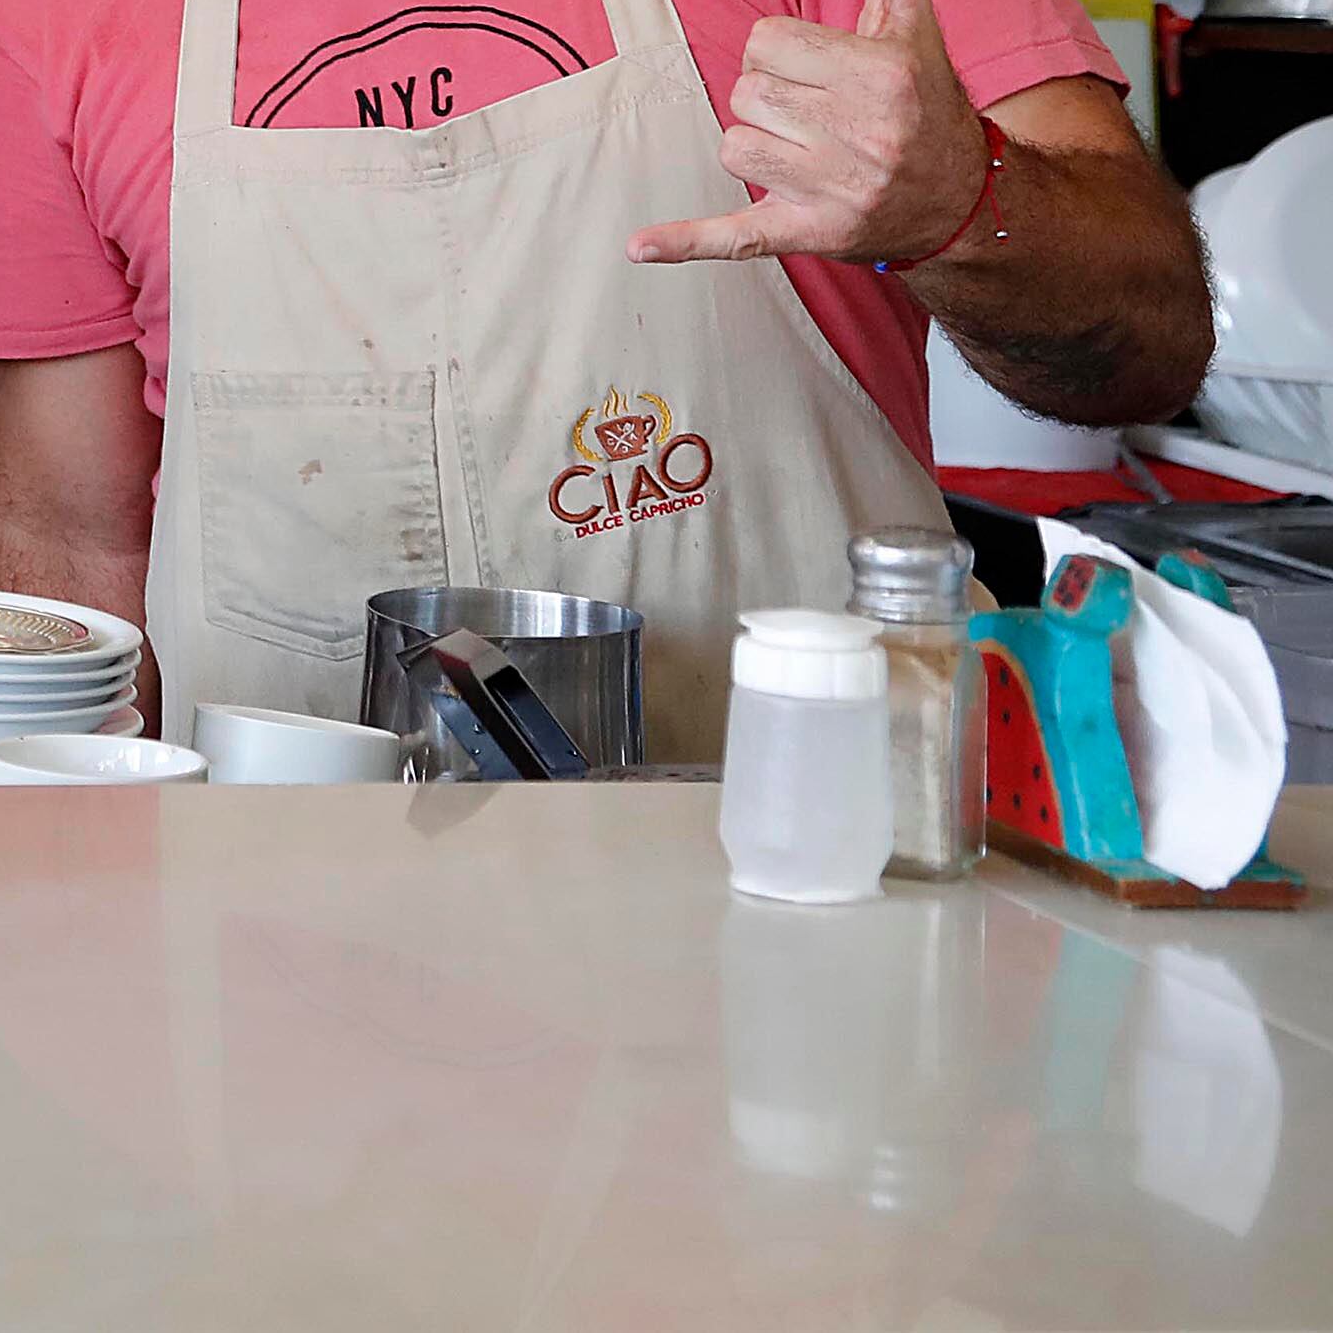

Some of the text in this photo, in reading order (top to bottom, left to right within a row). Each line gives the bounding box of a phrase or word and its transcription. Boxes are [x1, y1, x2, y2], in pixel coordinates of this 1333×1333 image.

[355, 67, 453, 129] NYC
[549, 433, 713, 524] CIAO
[576, 515, 624, 539] DULCE
[629, 492, 706, 523] CAPRICHO
